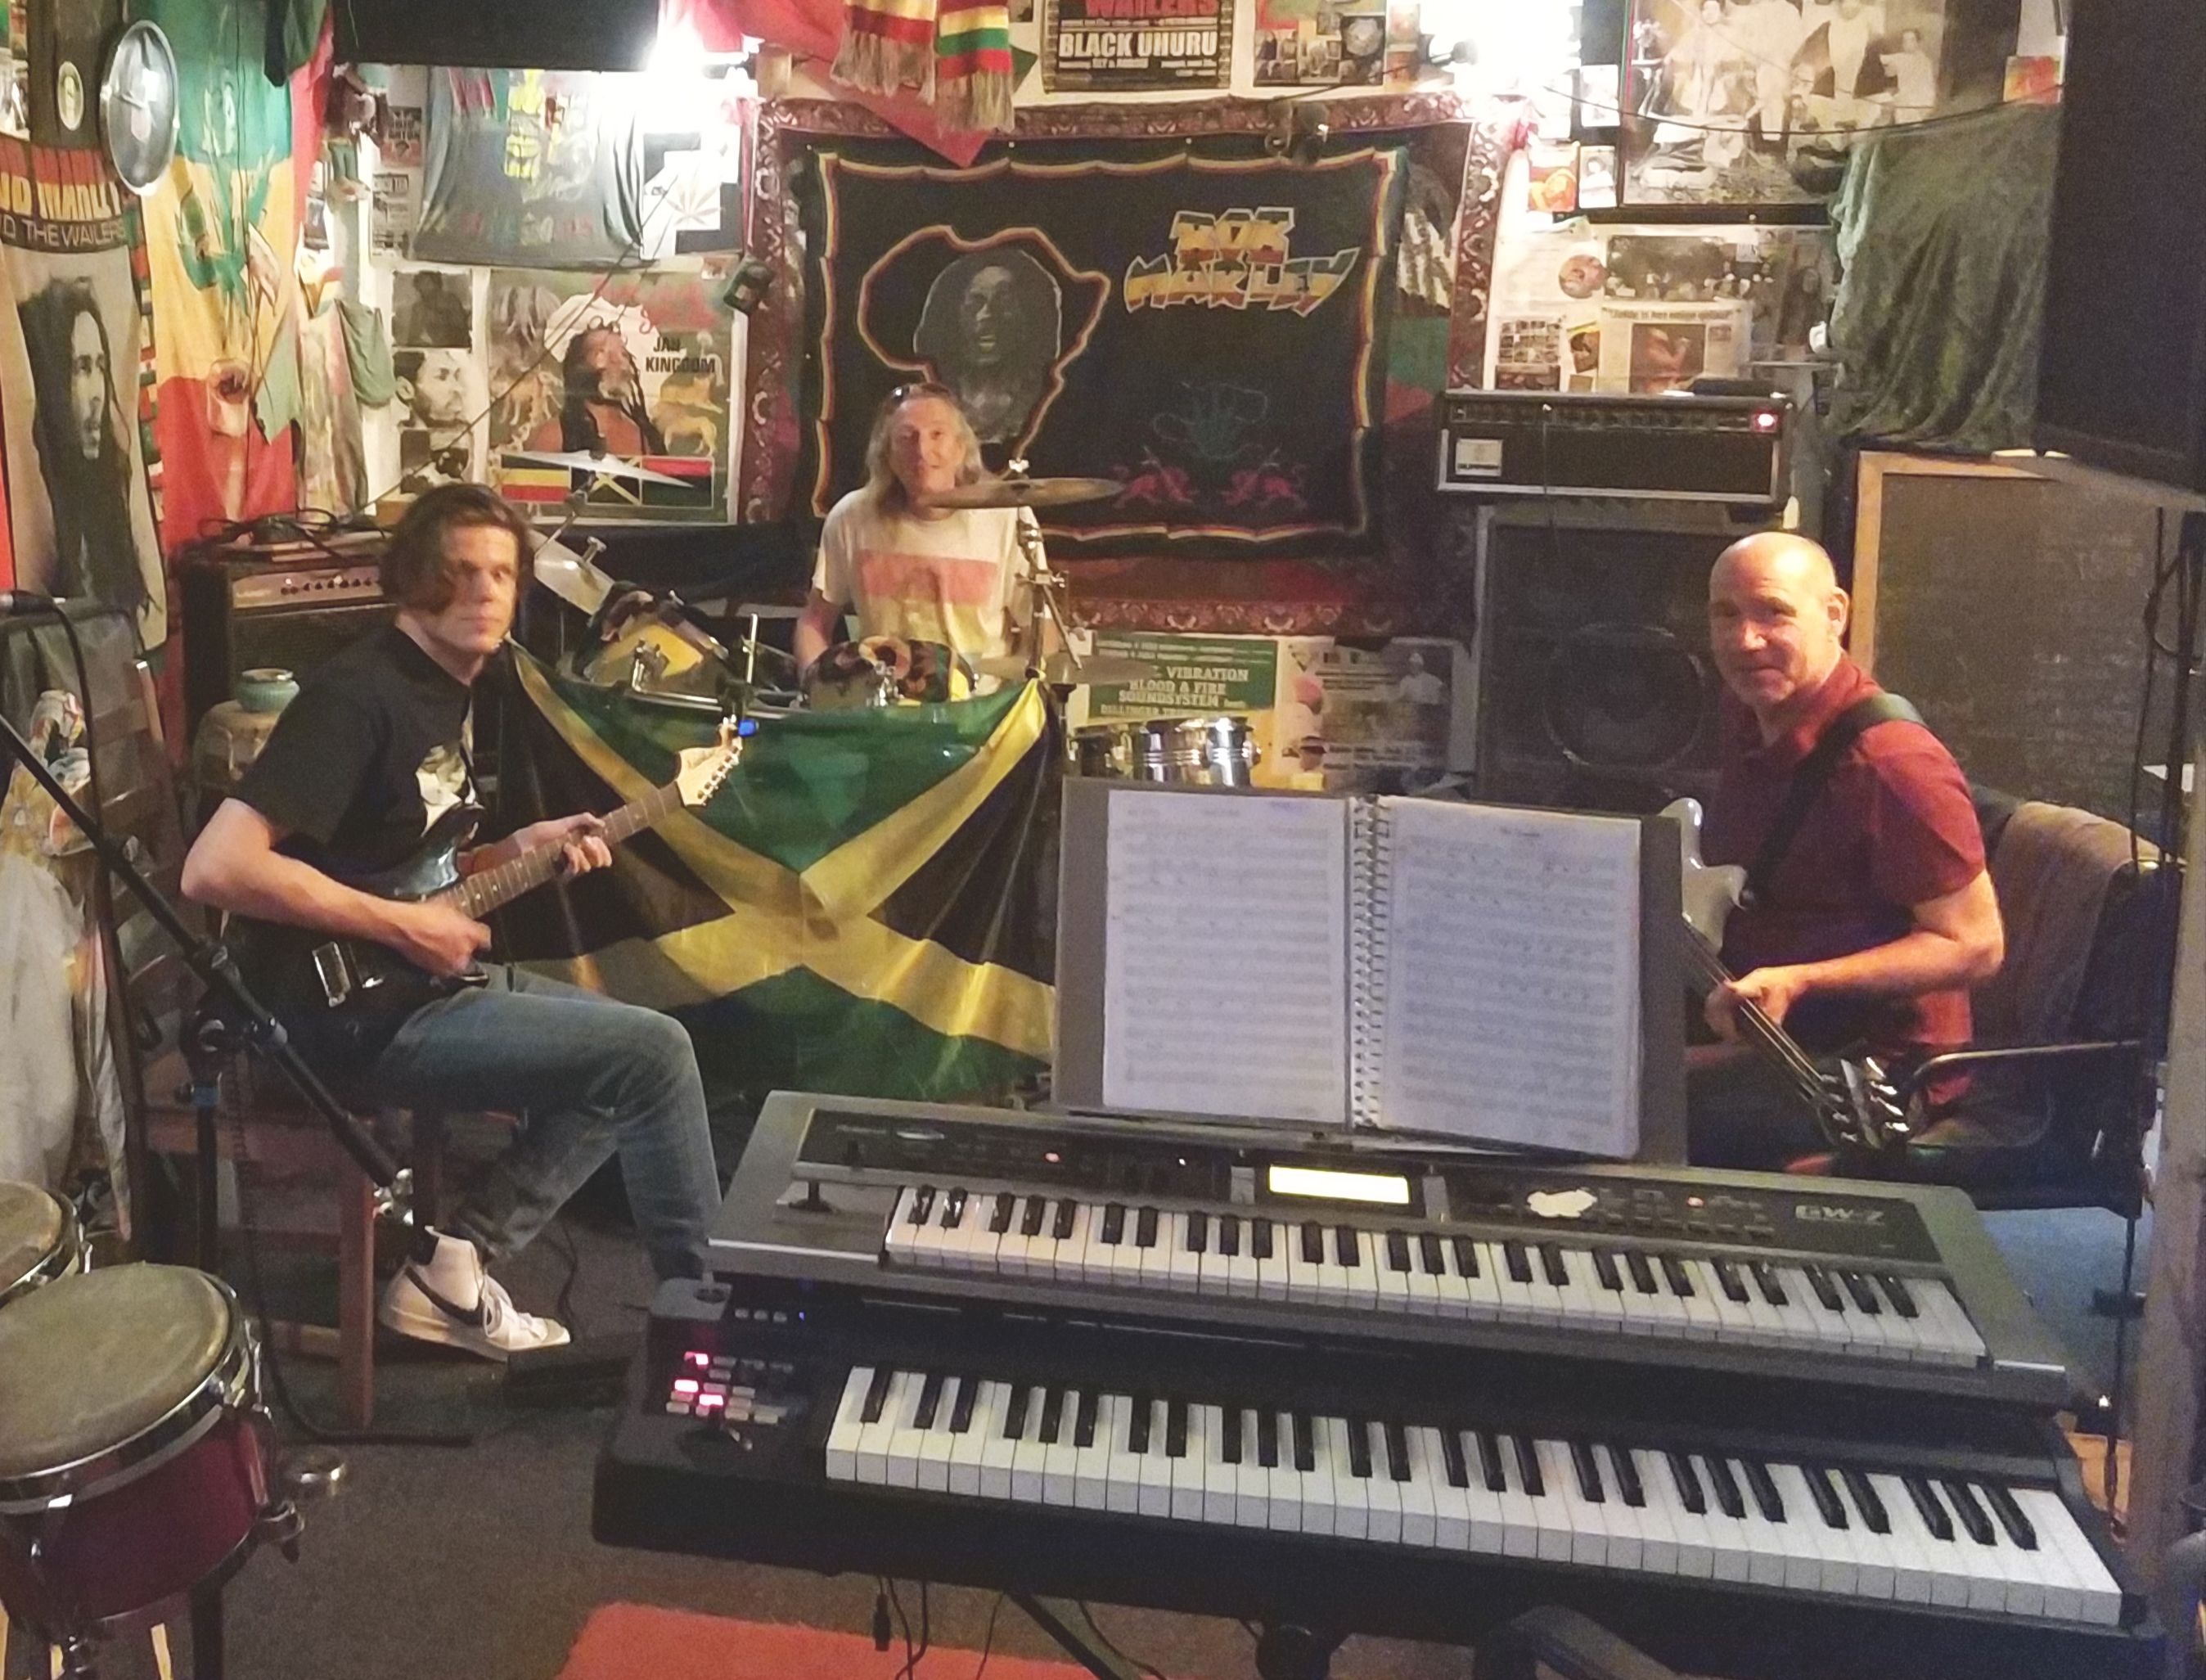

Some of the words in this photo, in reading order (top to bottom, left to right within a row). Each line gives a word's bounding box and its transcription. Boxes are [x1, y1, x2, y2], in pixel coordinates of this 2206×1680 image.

[1059, 32, 1133, 57] BLACK
[1137, 30, 1218, 57] UHURU
[22, 218, 60, 247] THE
[61, 218, 126, 248] WAILERS
[1169, 206, 1295, 266] BOB
[1123, 247, 1361, 318] MARLEY
[646, 356, 716, 374] KINGDOM
[1166, 665, 1249, 682] VIBRATION
[1194, 682, 1227, 695] FIRE
